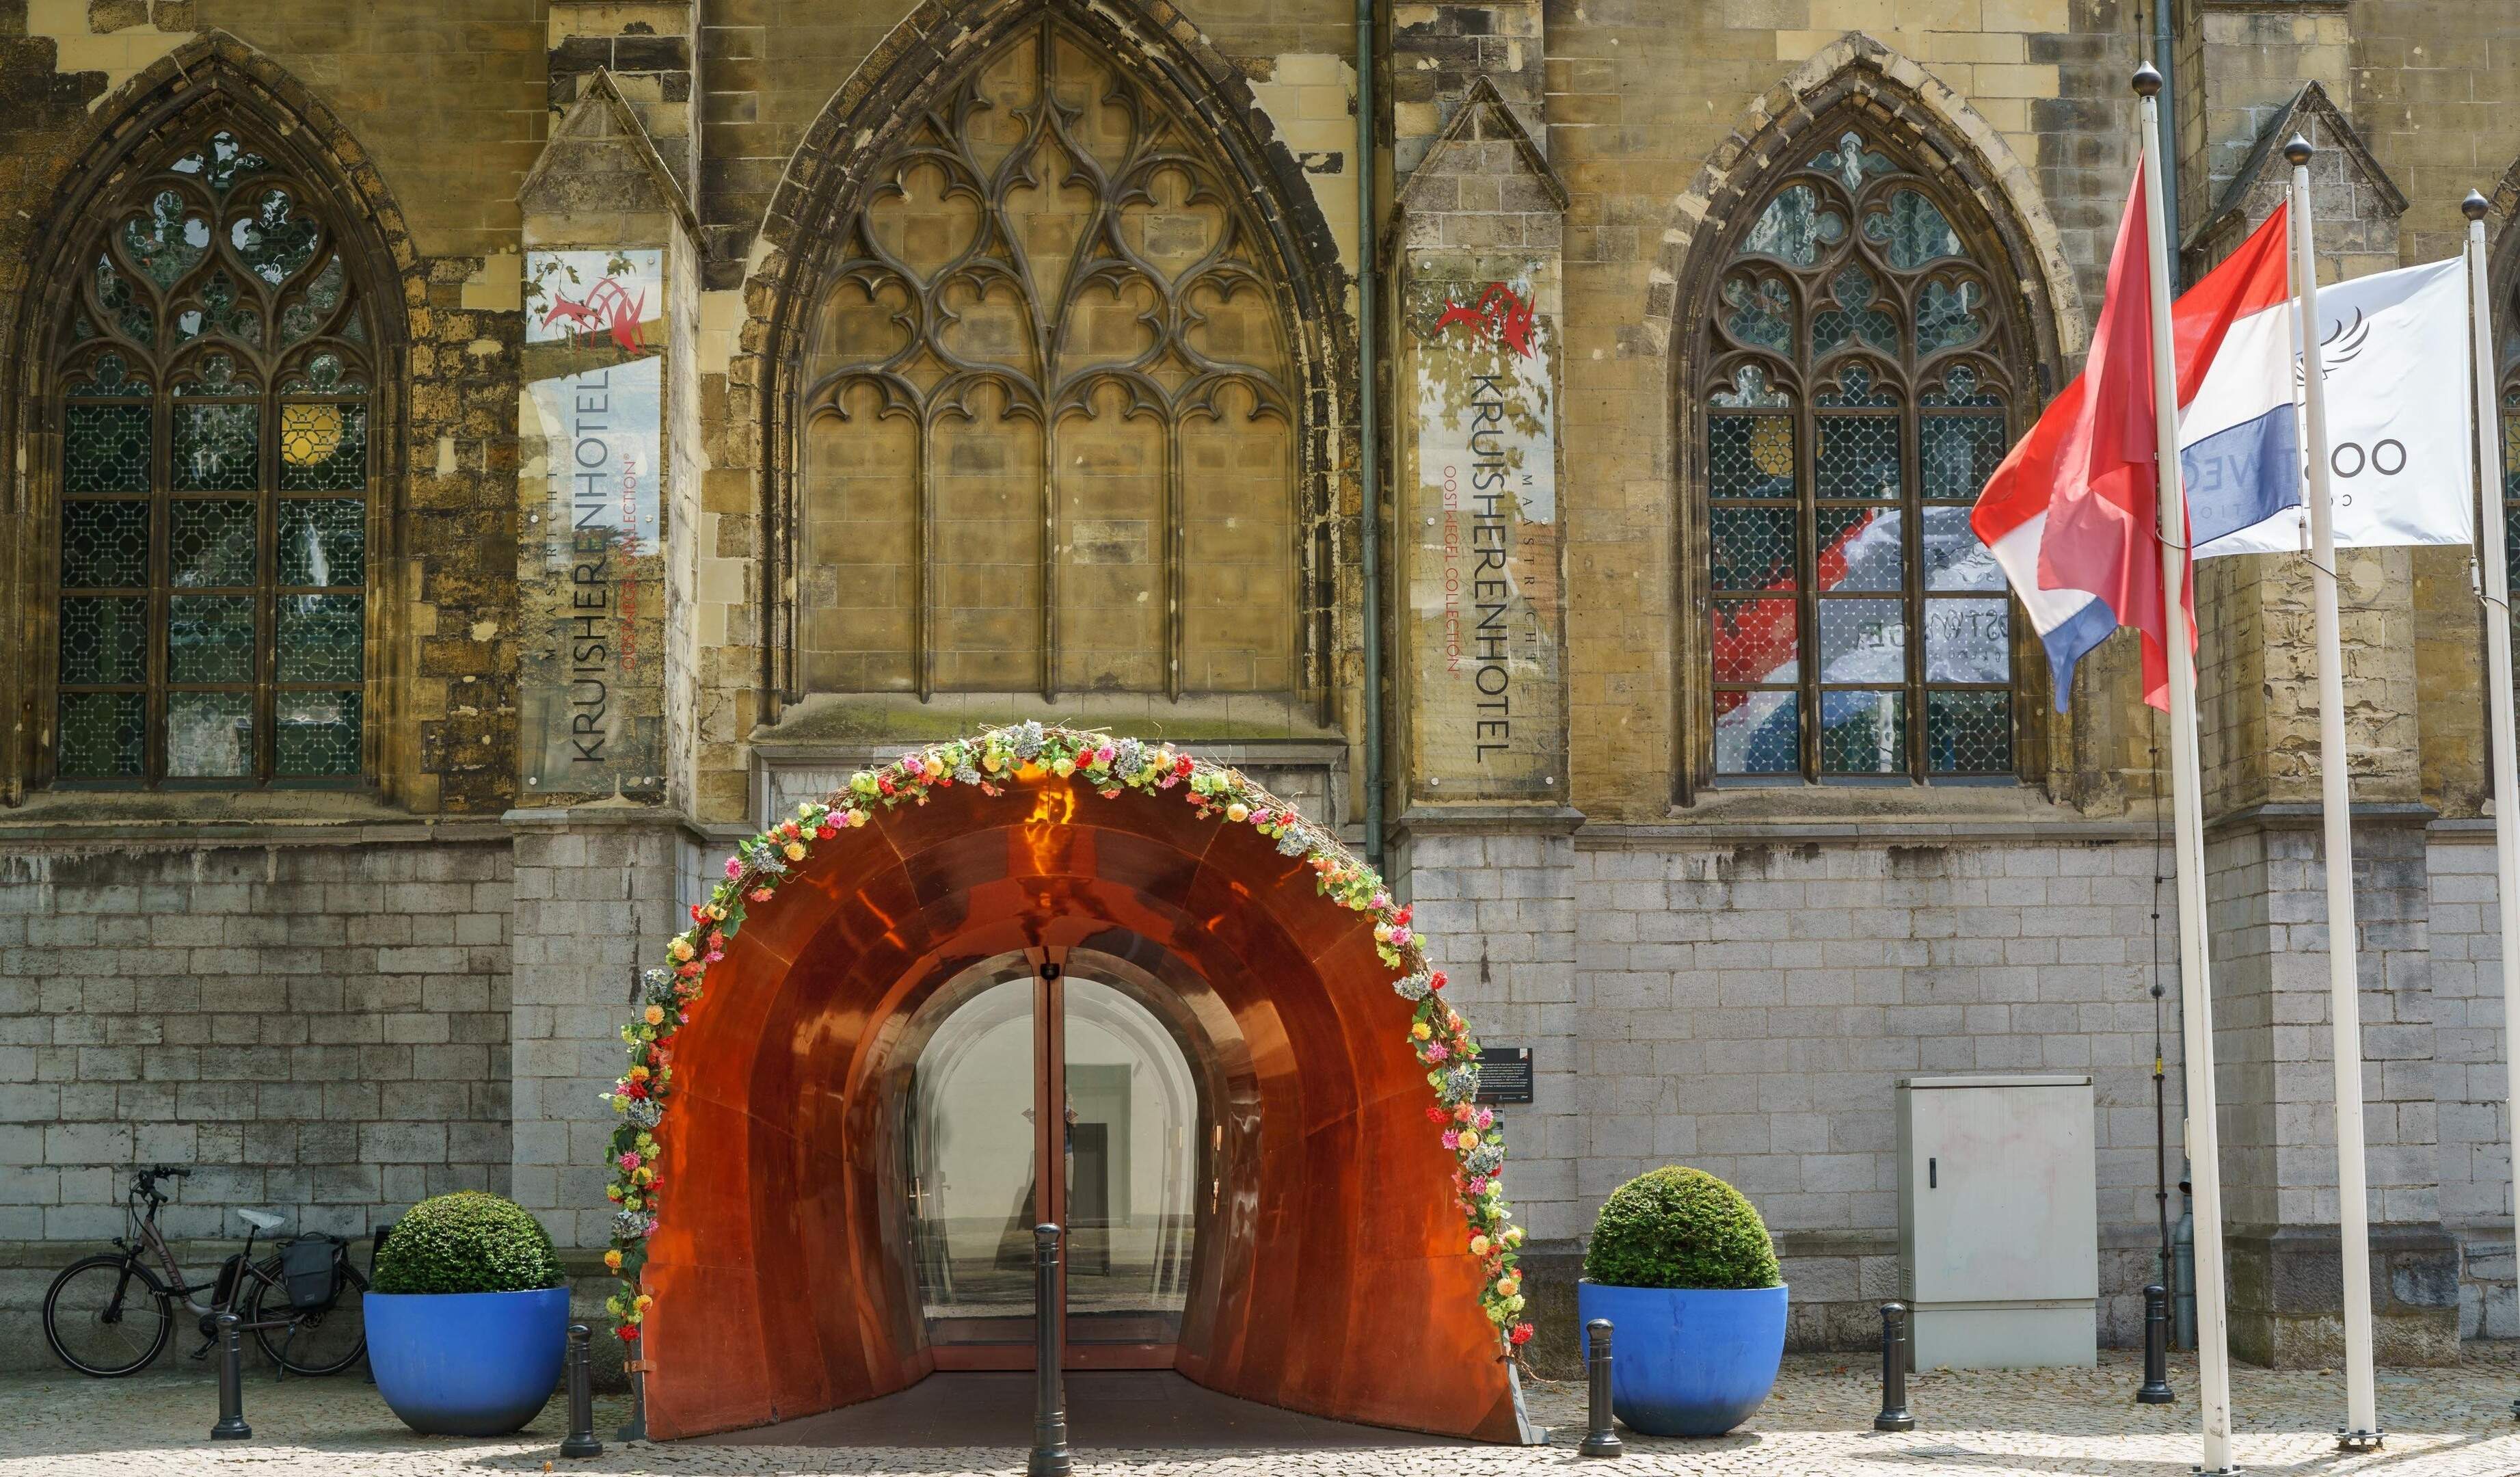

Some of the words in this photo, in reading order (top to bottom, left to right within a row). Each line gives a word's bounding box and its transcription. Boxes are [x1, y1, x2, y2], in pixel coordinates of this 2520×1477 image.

[546, 471, 558, 661] MAASTRICHT
[572, 370, 609, 762] KRUISHERENHOTEL
[1443, 465, 1458, 562] OOSTWEGEL
[1470, 375, 1510, 764] KRUISHERENHOTEL
[1522, 475, 1537, 665] MAASTRICHT
[621, 573, 636, 671] OOSTWEGEL
